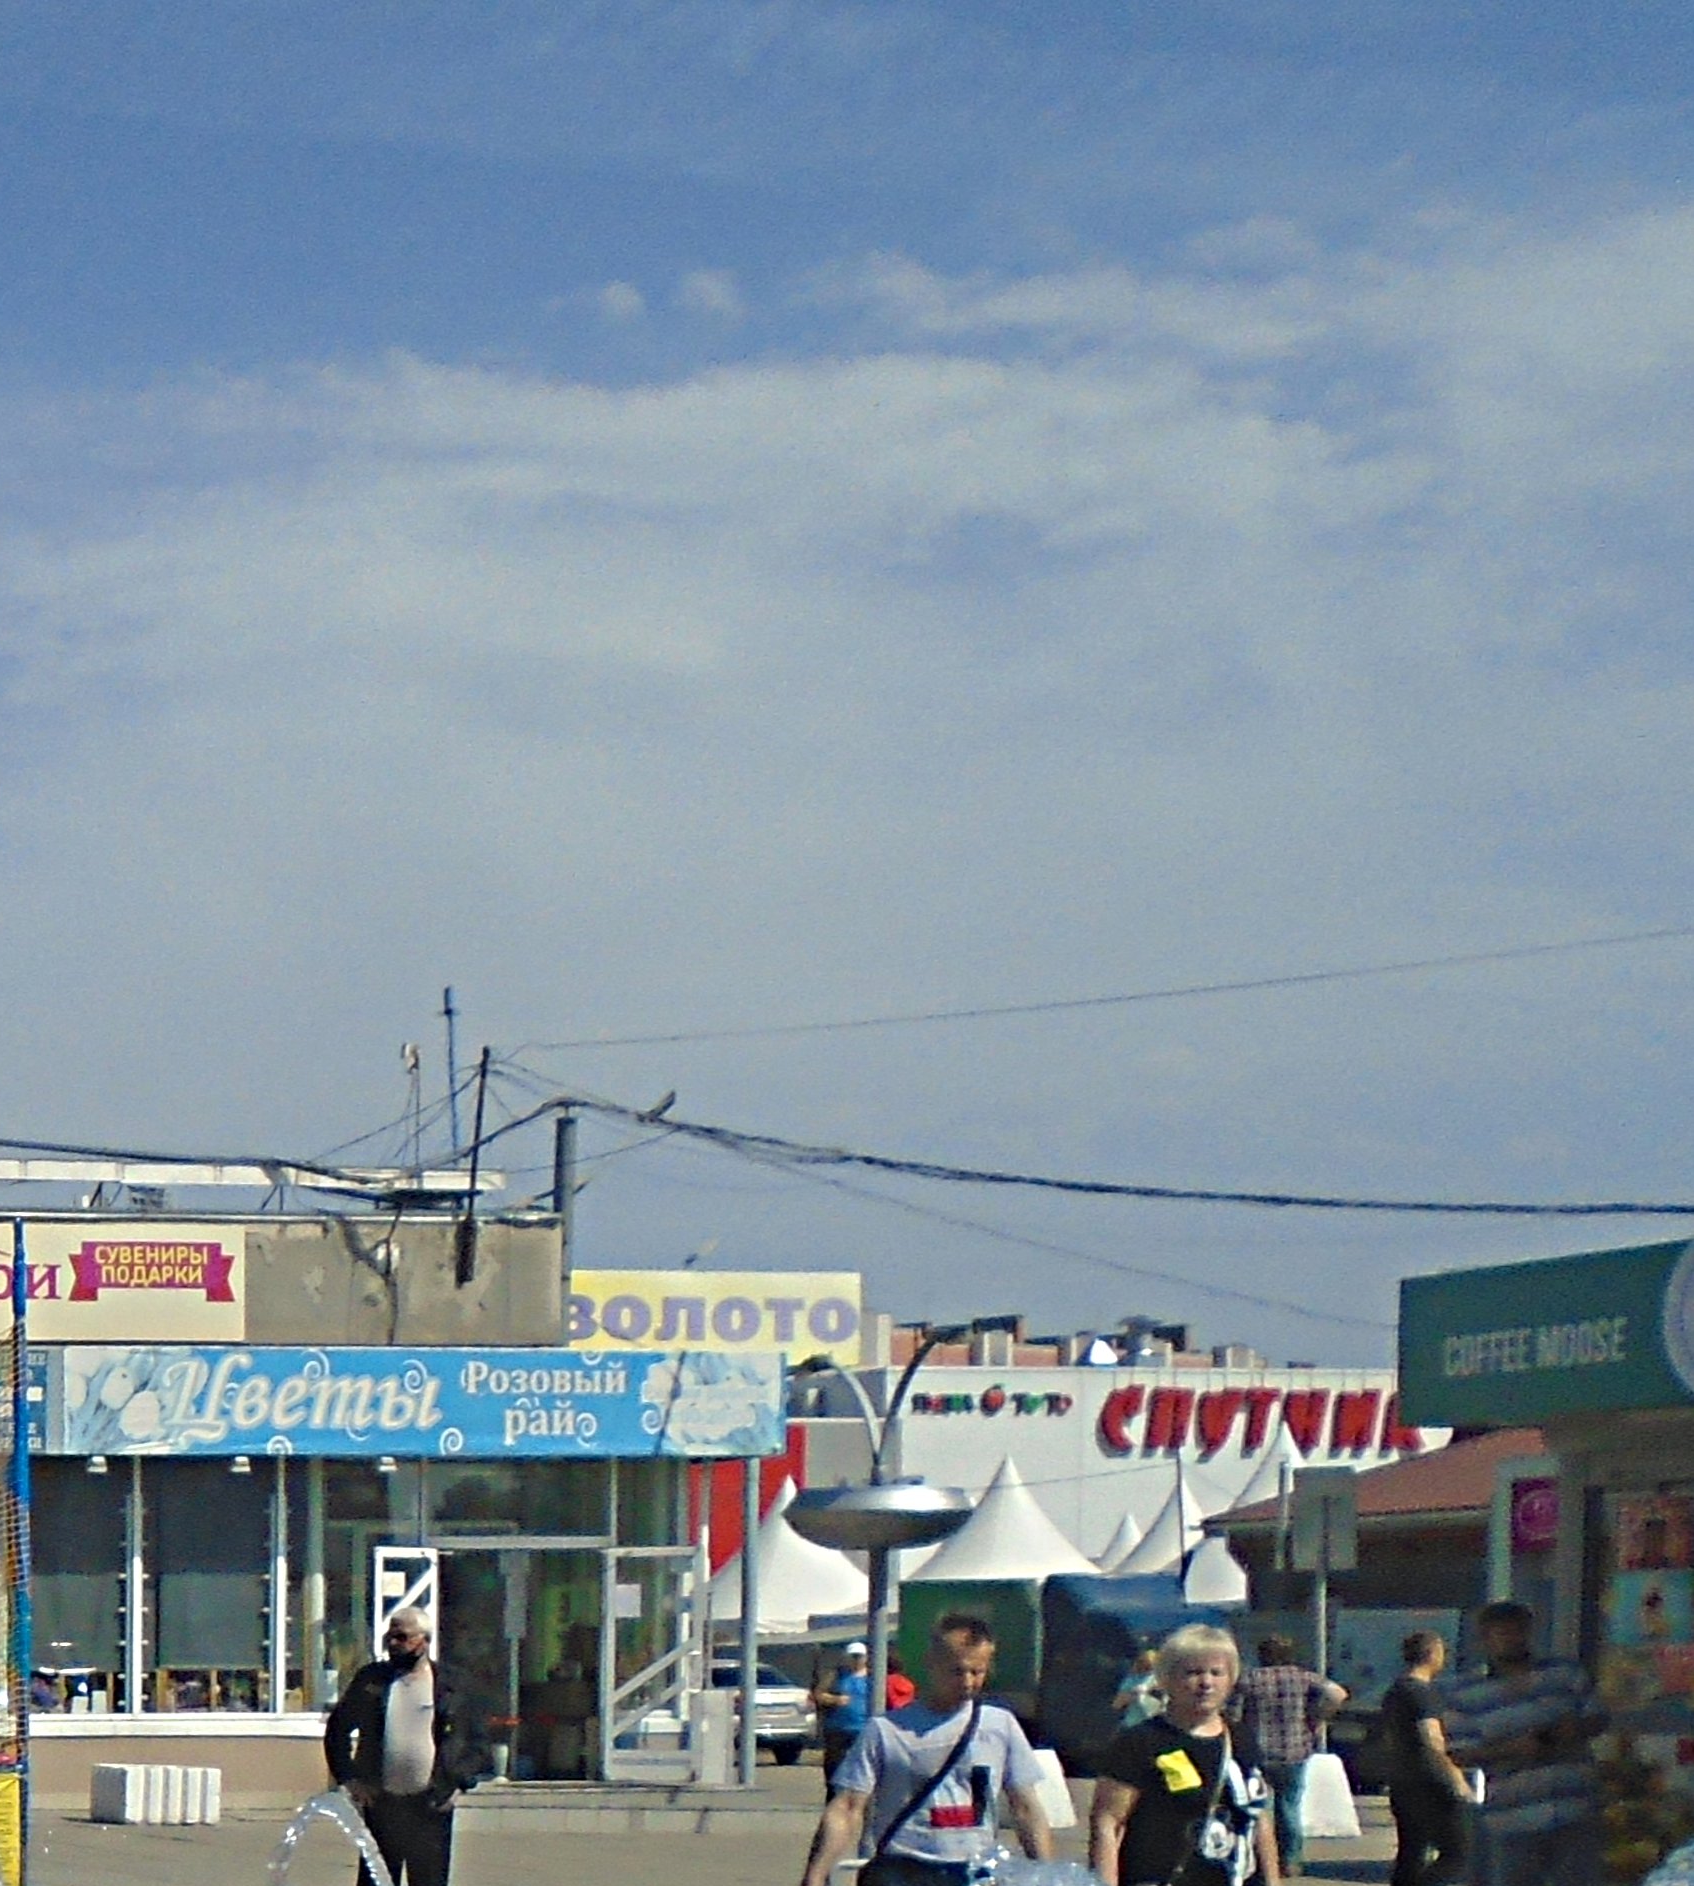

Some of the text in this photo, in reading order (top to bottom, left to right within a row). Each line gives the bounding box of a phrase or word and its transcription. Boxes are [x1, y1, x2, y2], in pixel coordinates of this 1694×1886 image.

[93, 1245, 209, 1266] СУВЕНИРЫ
[101, 1265, 204, 1287] ПОДАРКИ
[463, 1360, 628, 1396] Розовый
[163, 1354, 444, 1449] Цветы
[503, 1398, 577, 1446] рай
[1098, 1383, 1423, 1462] СПУТНИК
